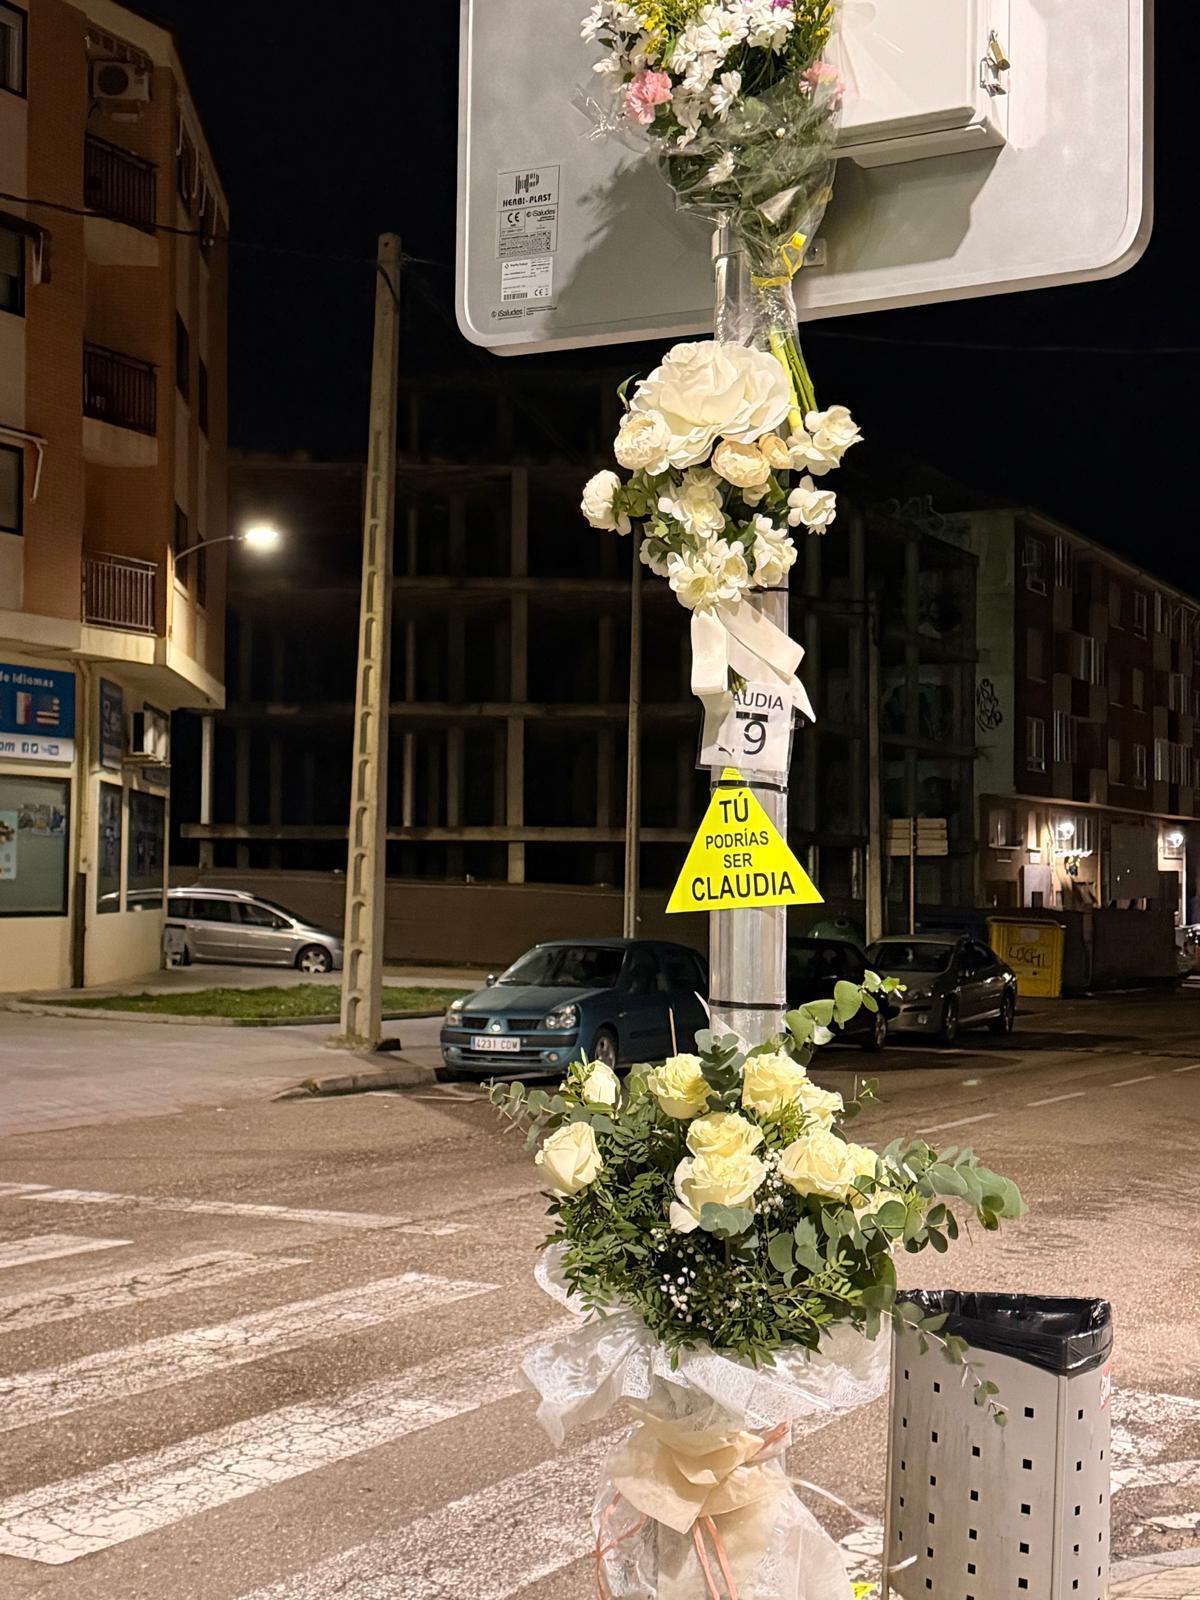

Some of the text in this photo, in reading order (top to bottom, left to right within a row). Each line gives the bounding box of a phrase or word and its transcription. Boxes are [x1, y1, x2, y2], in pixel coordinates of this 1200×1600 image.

[719, 791, 749, 823] TÚ
[705, 828, 769, 850] PODRÍAS
[723, 852, 753, 869] SER
[691, 871, 796, 902] CLAUDIA
